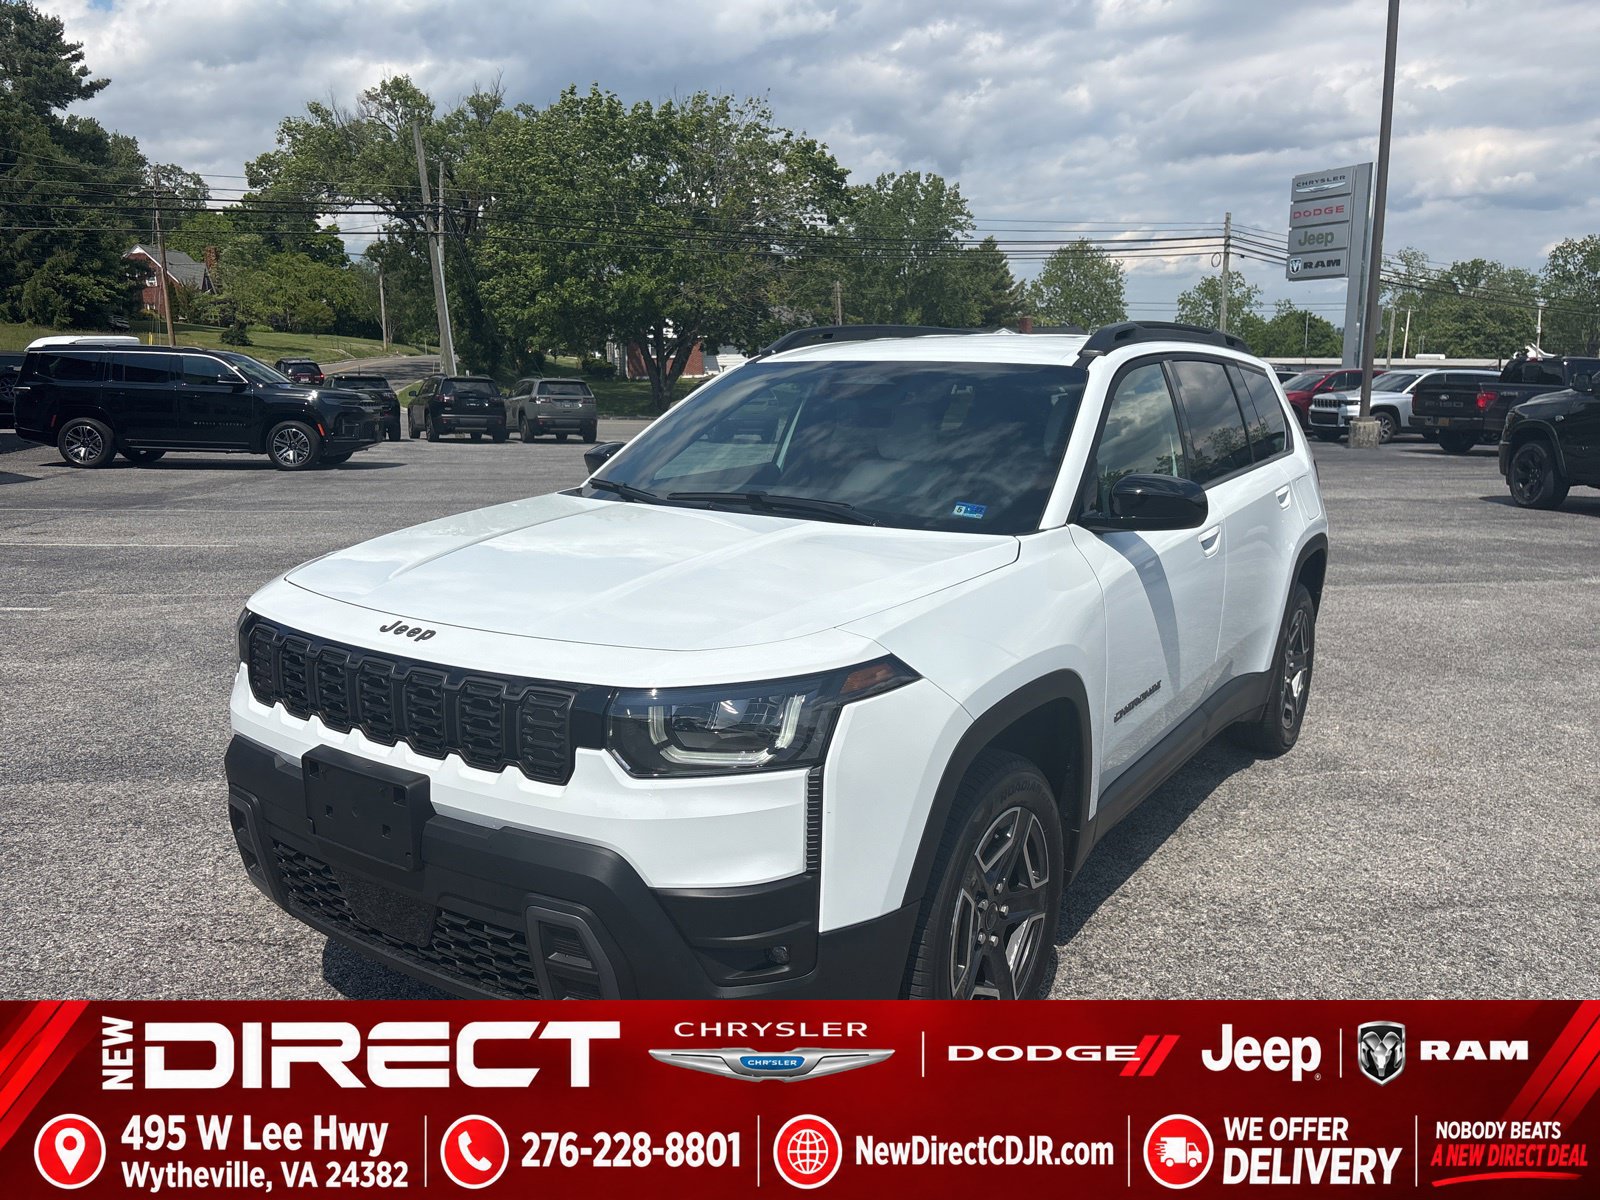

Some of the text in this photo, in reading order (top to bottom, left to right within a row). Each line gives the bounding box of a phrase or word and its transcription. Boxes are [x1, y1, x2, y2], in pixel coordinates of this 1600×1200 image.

[1295, 174, 1346, 188] CHRYSLER
[1293, 204, 1345, 219] DODGE
[1298, 231, 1335, 246] Jeep
[1303, 259, 1341, 269] RAM
[379, 620, 437, 642] Jeep
